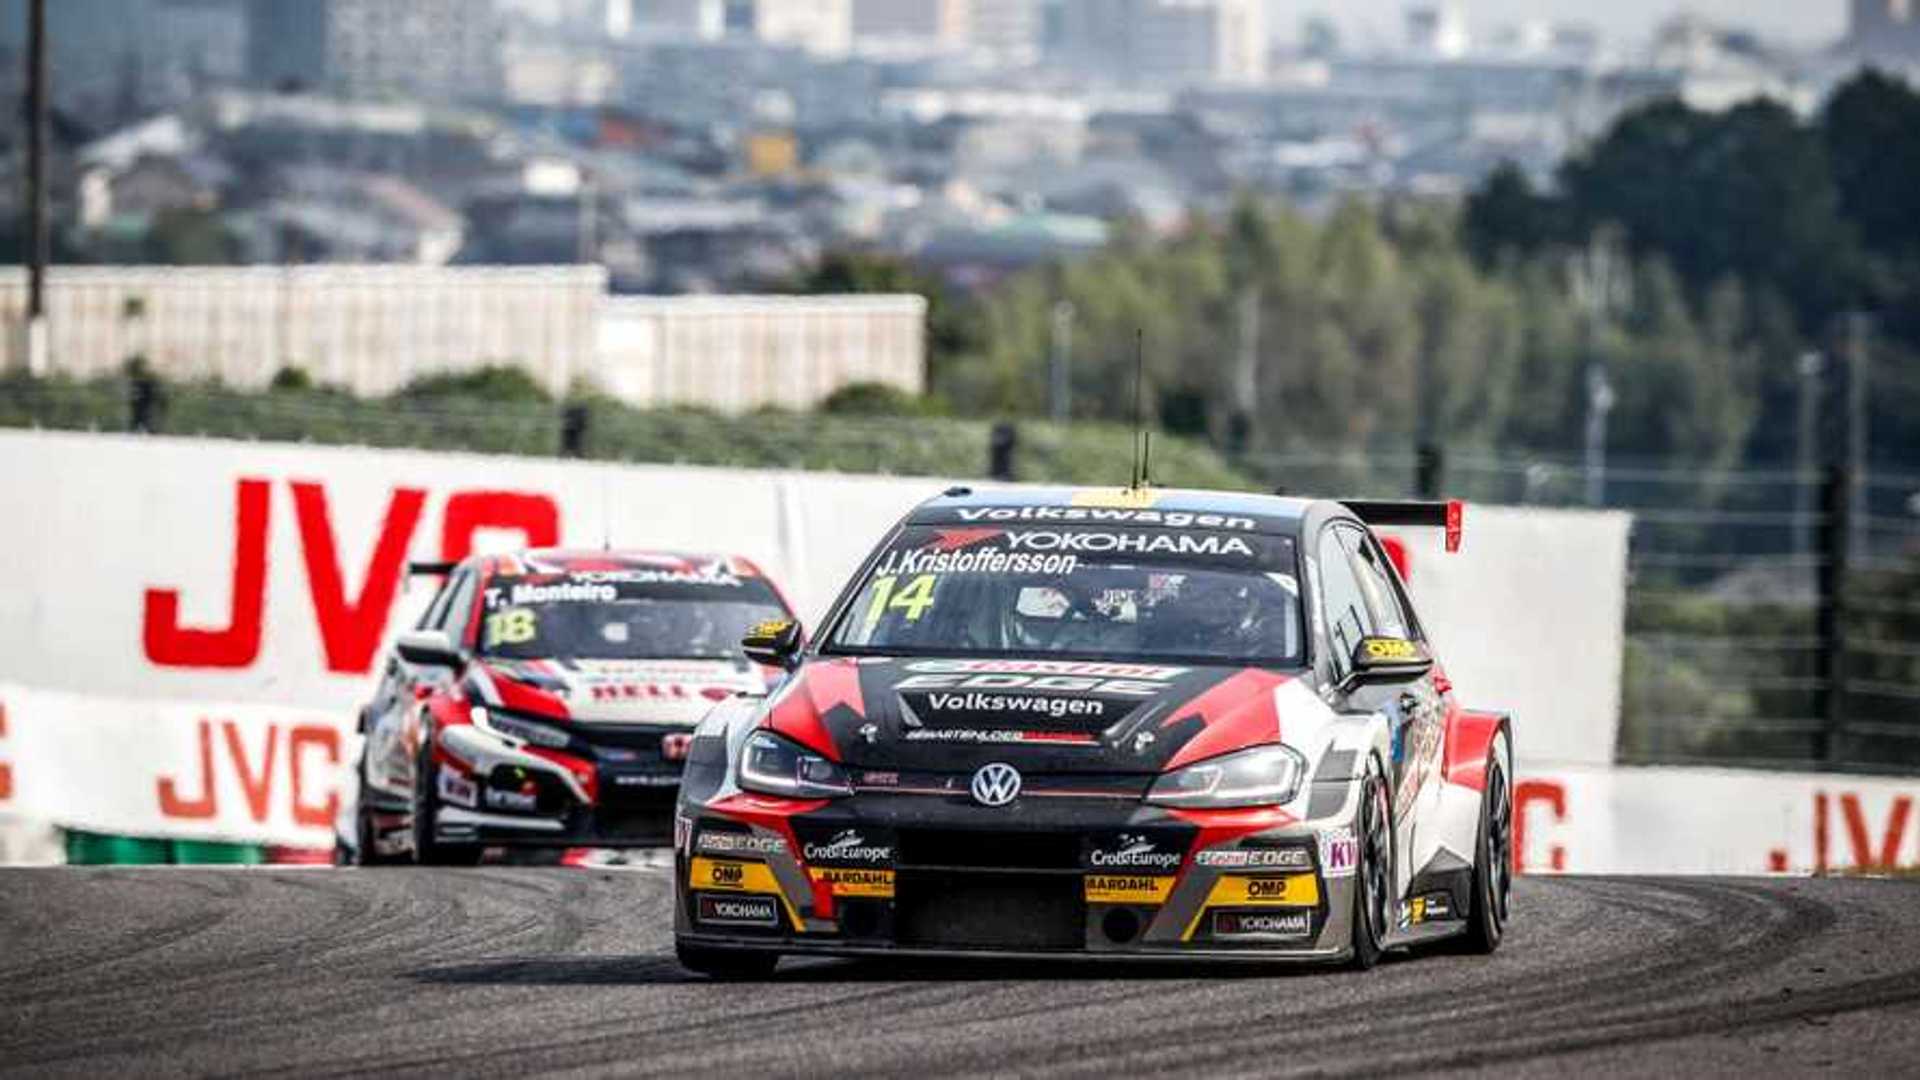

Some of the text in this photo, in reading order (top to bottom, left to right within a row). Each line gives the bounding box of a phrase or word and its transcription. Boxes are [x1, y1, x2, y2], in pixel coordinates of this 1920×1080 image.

[956, 506, 1256, 530] Volkswagen
[1004, 530, 1253, 556] YOKOHAMA
[512, 582, 618, 604] Monteiro
[864, 574, 936, 625] 14
[487, 607, 537, 646] 18
[893, 674, 1176, 695] EDGE
[928, 692, 1104, 717] Volkswagen
[154, 718, 341, 828] JVC
[1245, 849, 1305, 867] EDGE
[1247, 879, 1286, 897] OMP
[1237, 913, 1306, 930] YOKOHAMA
